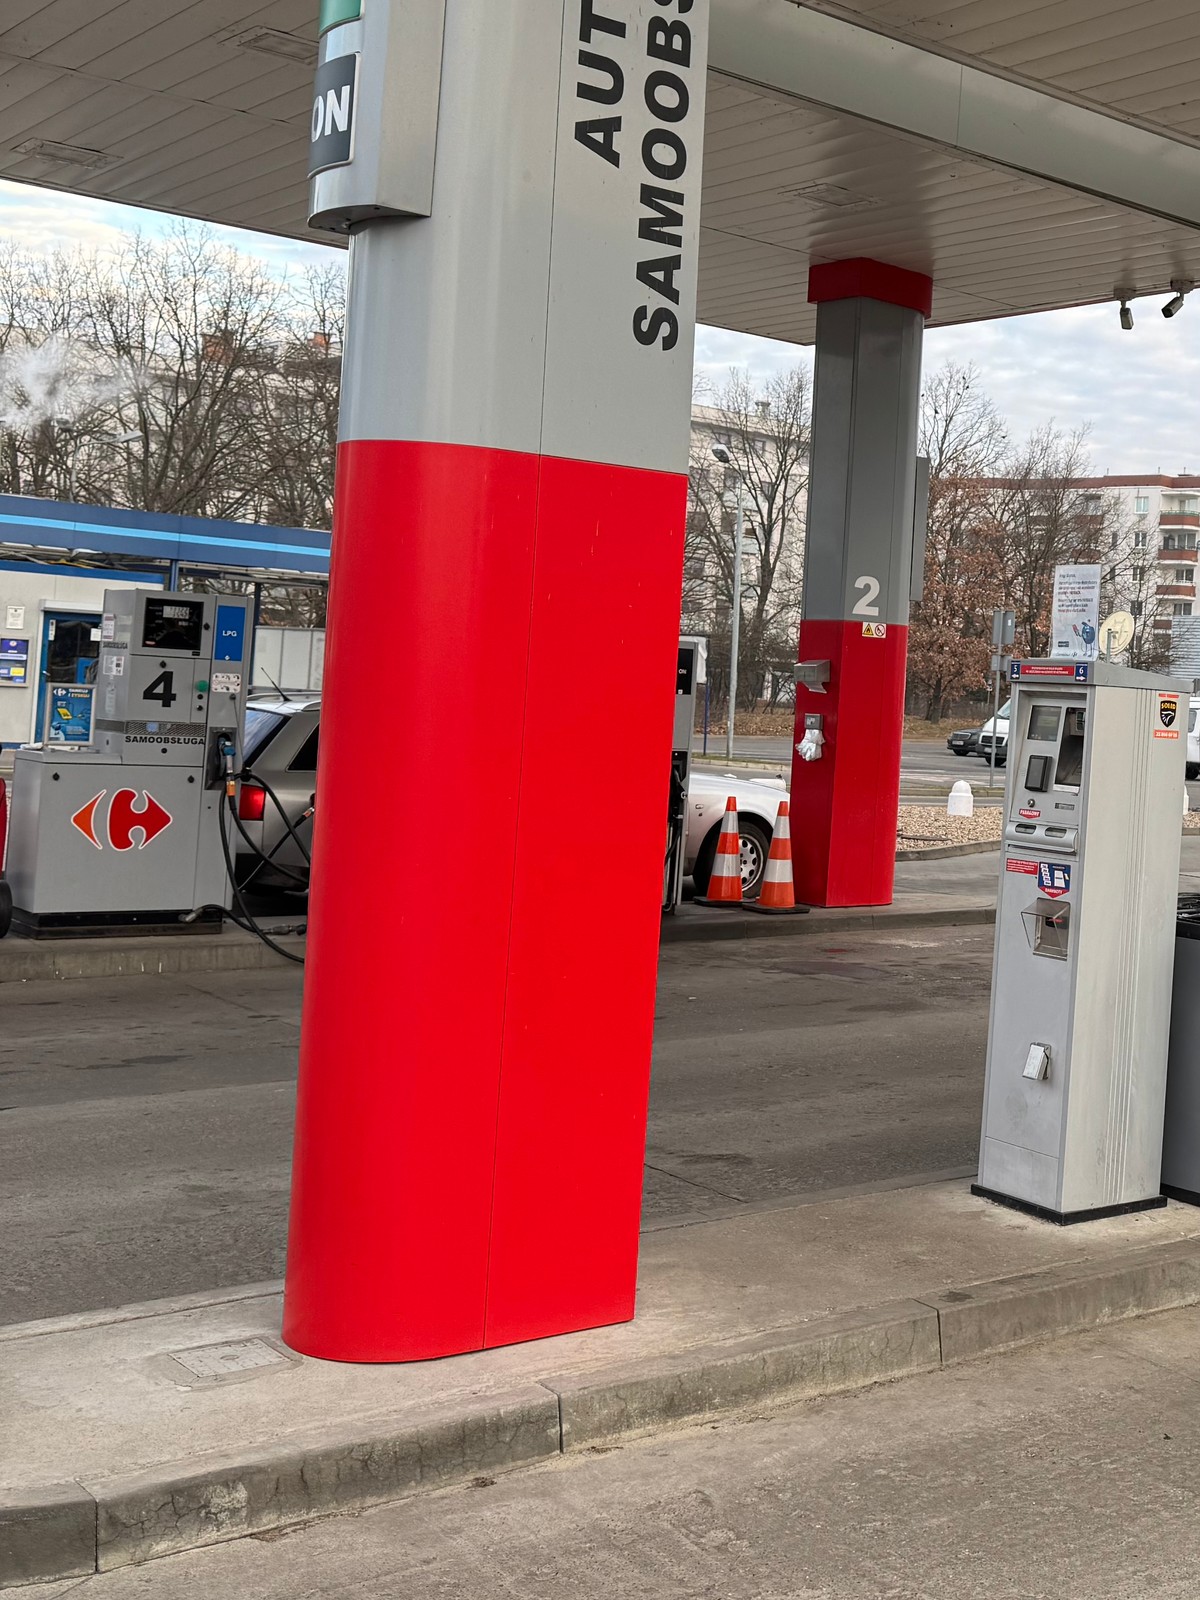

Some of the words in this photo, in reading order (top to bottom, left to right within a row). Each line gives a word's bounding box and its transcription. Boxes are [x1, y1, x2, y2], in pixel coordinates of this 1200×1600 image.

[312, 85, 350, 143] ON
[632, 0, 694, 351] SAMOOB
[852, 575, 881, 617] 2
[142, 670, 177, 708] 4
[1078, 667, 1084, 675] 6
[125, 735, 206, 745] SAMOOBSŁUGA
